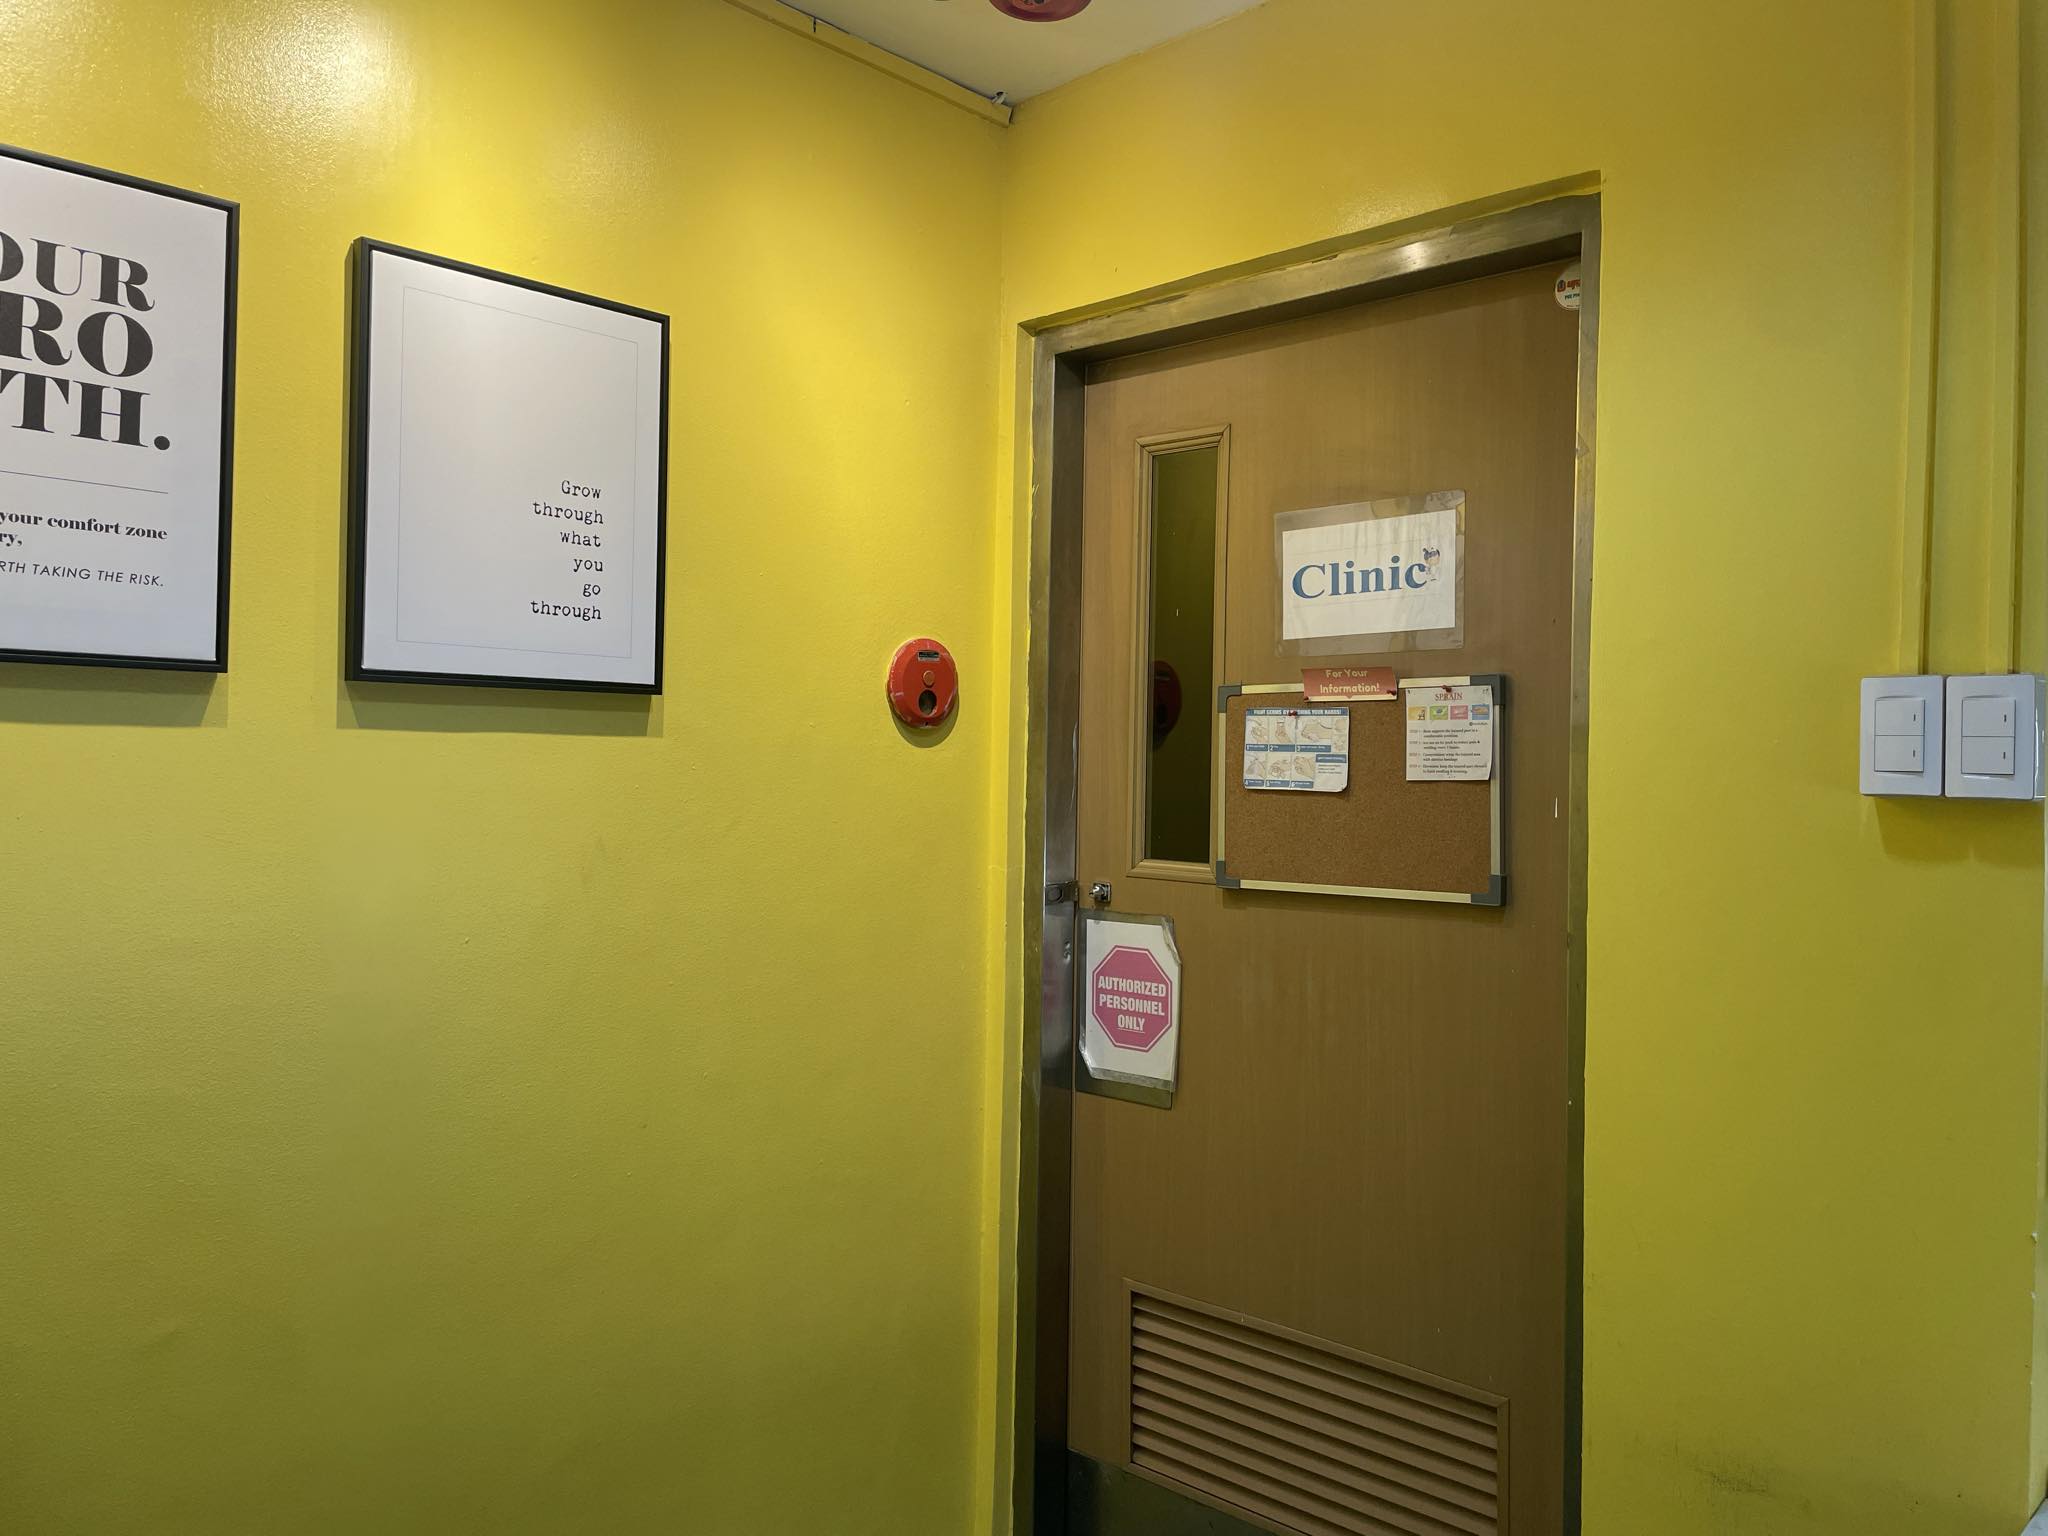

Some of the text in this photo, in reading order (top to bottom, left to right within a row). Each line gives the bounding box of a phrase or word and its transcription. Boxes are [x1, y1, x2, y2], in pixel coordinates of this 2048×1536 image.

[561, 479, 602, 499] Grow
[532, 501, 604, 526] through
[0, 511, 168, 540] your comfort zone
[560, 530, 601, 548] what
[33, 563, 91, 580] TAKING
[98, 570, 124, 583] THE
[129, 573, 164, 587] RISK.
[573, 558, 604, 573] you
[1291, 555, 1428, 599] Clinic
[583, 583, 601, 598] go
[530, 600, 602, 622] through
[1325, 669, 1368, 678] For Your
[1319, 682, 1380, 694] Information!
[1434, 692, 1464, 702] SPRAIN
[1097, 976, 1167, 997] AUTHORIZED
[1099, 994, 1165, 1016] PERSONNEL
[1117, 1014, 1146, 1032] ONLY
